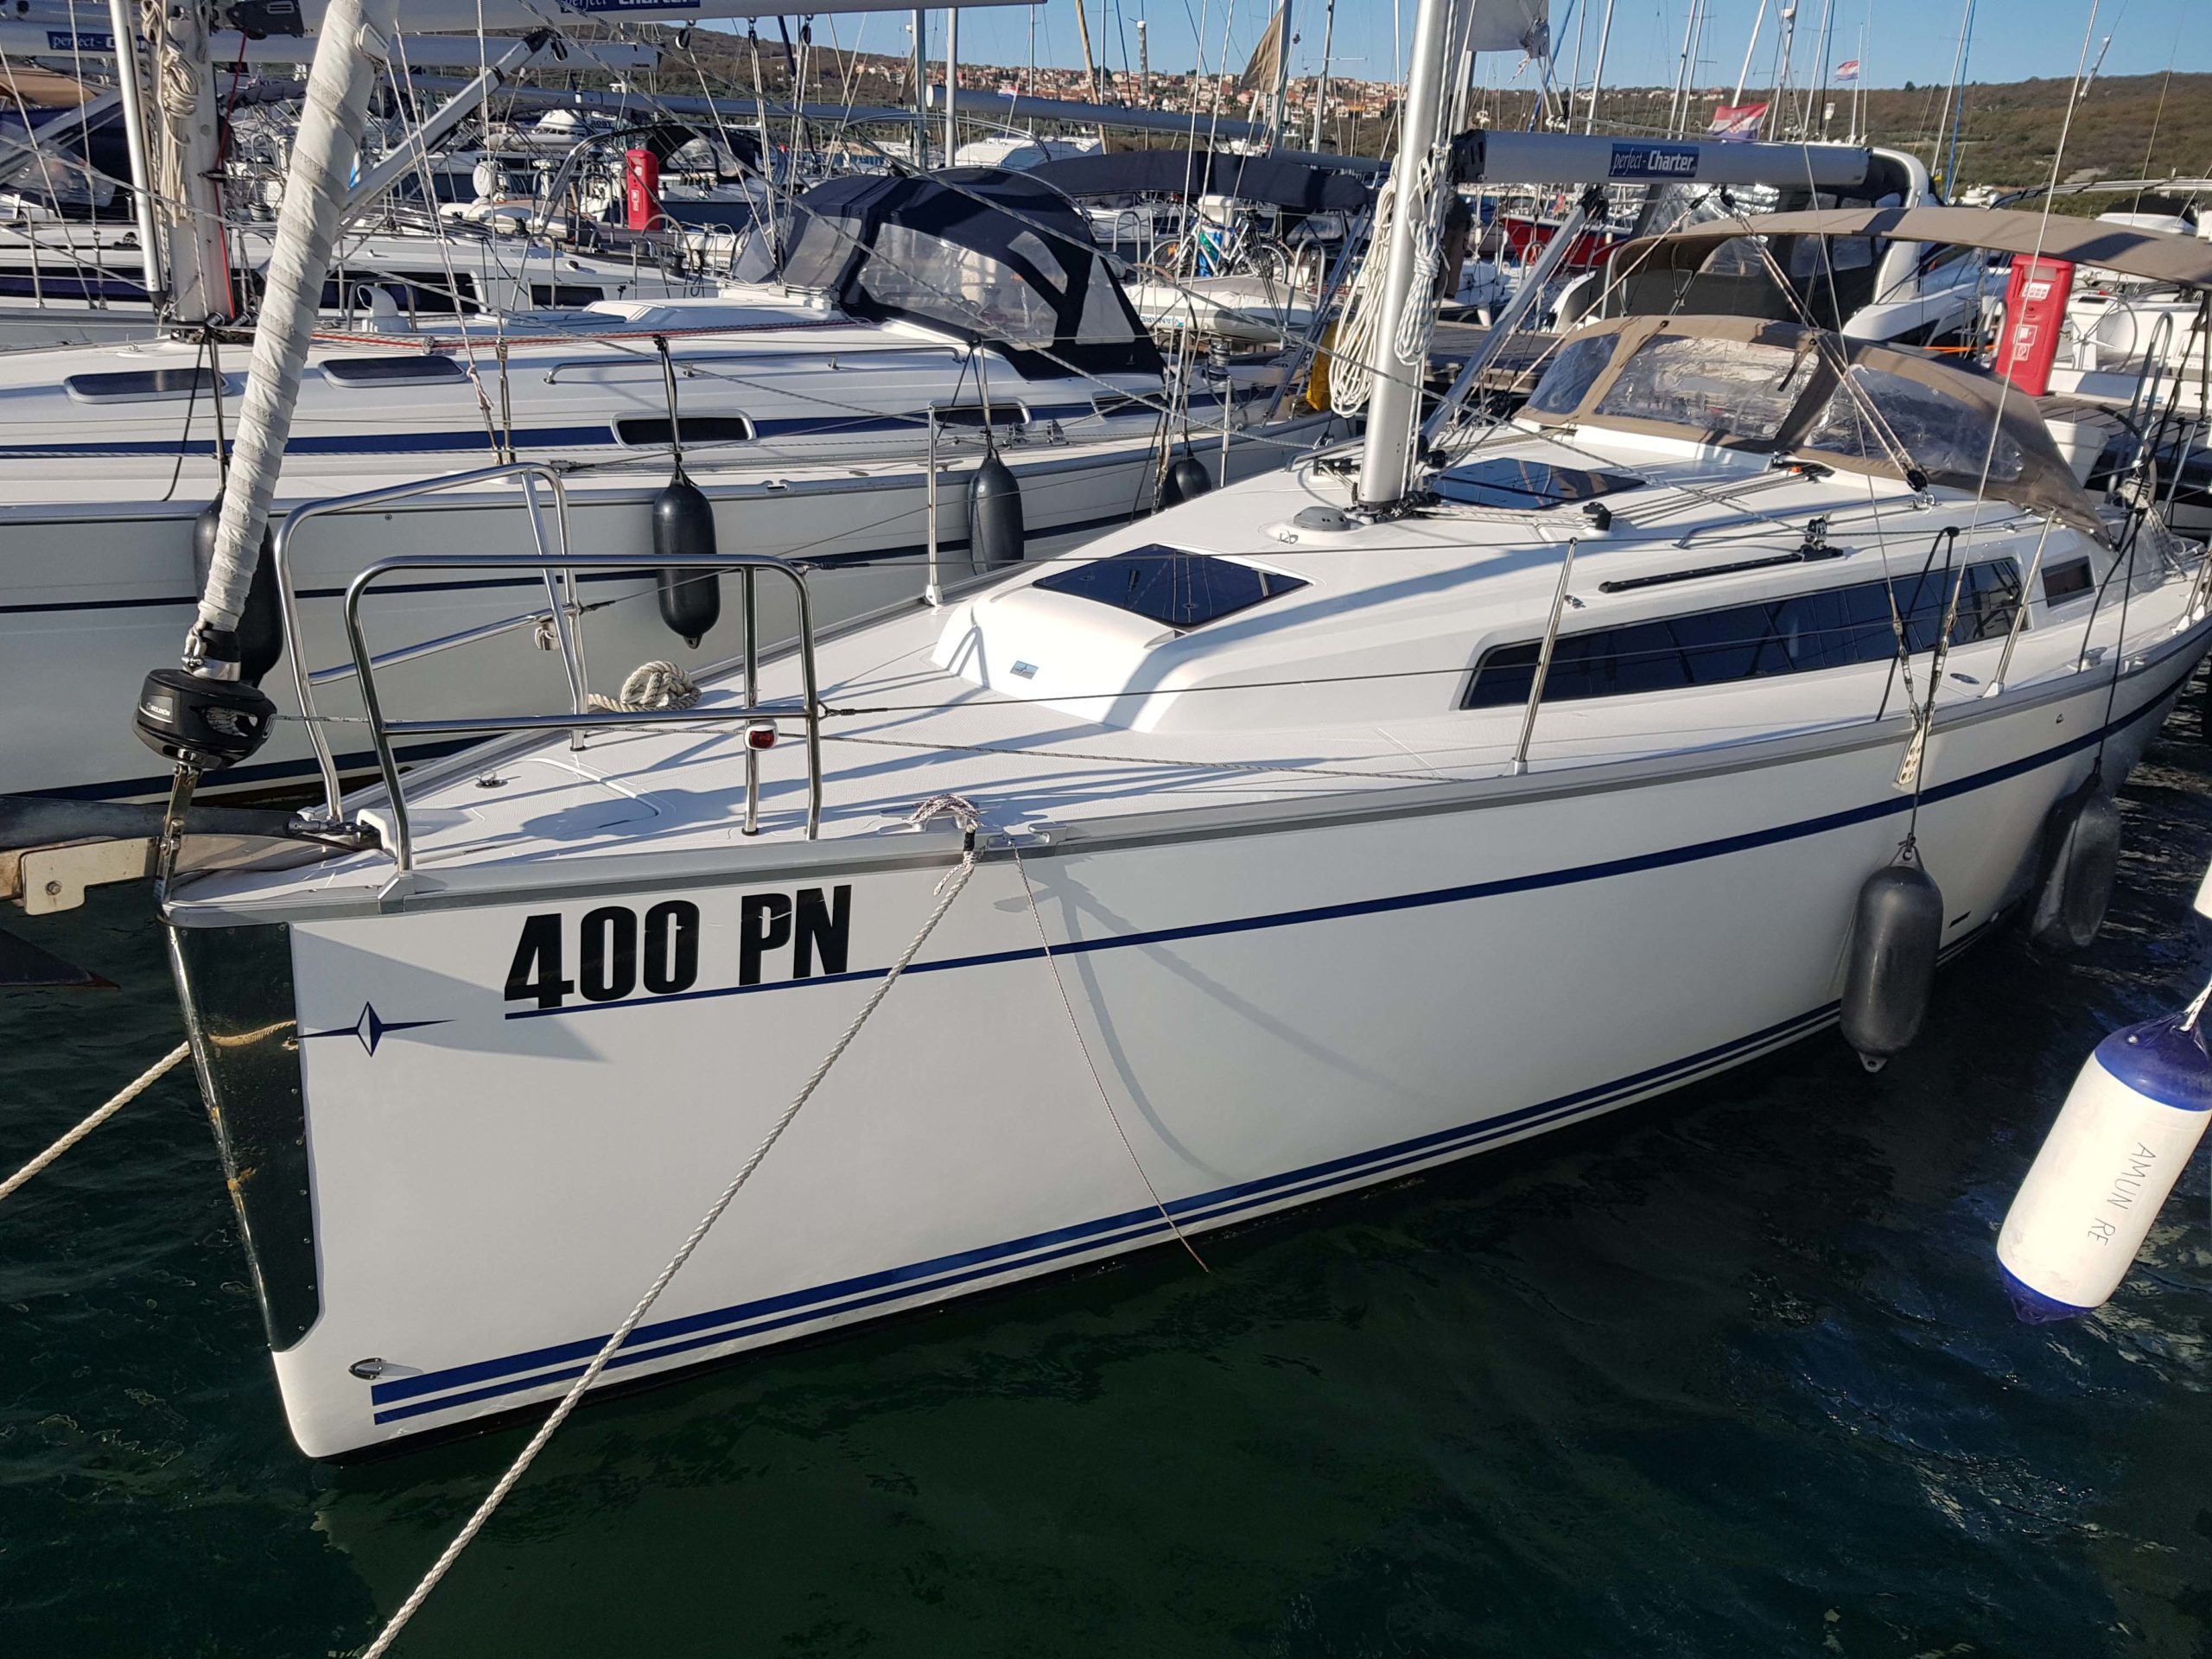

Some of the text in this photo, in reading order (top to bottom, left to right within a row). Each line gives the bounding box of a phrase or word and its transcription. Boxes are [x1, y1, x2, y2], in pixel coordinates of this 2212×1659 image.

[53, 36, 95, 49] perect
[1648, 150, 1694, 171] Charter
[505, 885, 852, 1009] 400 PN
[2088, 1142, 2156, 1246] AMUN RE
